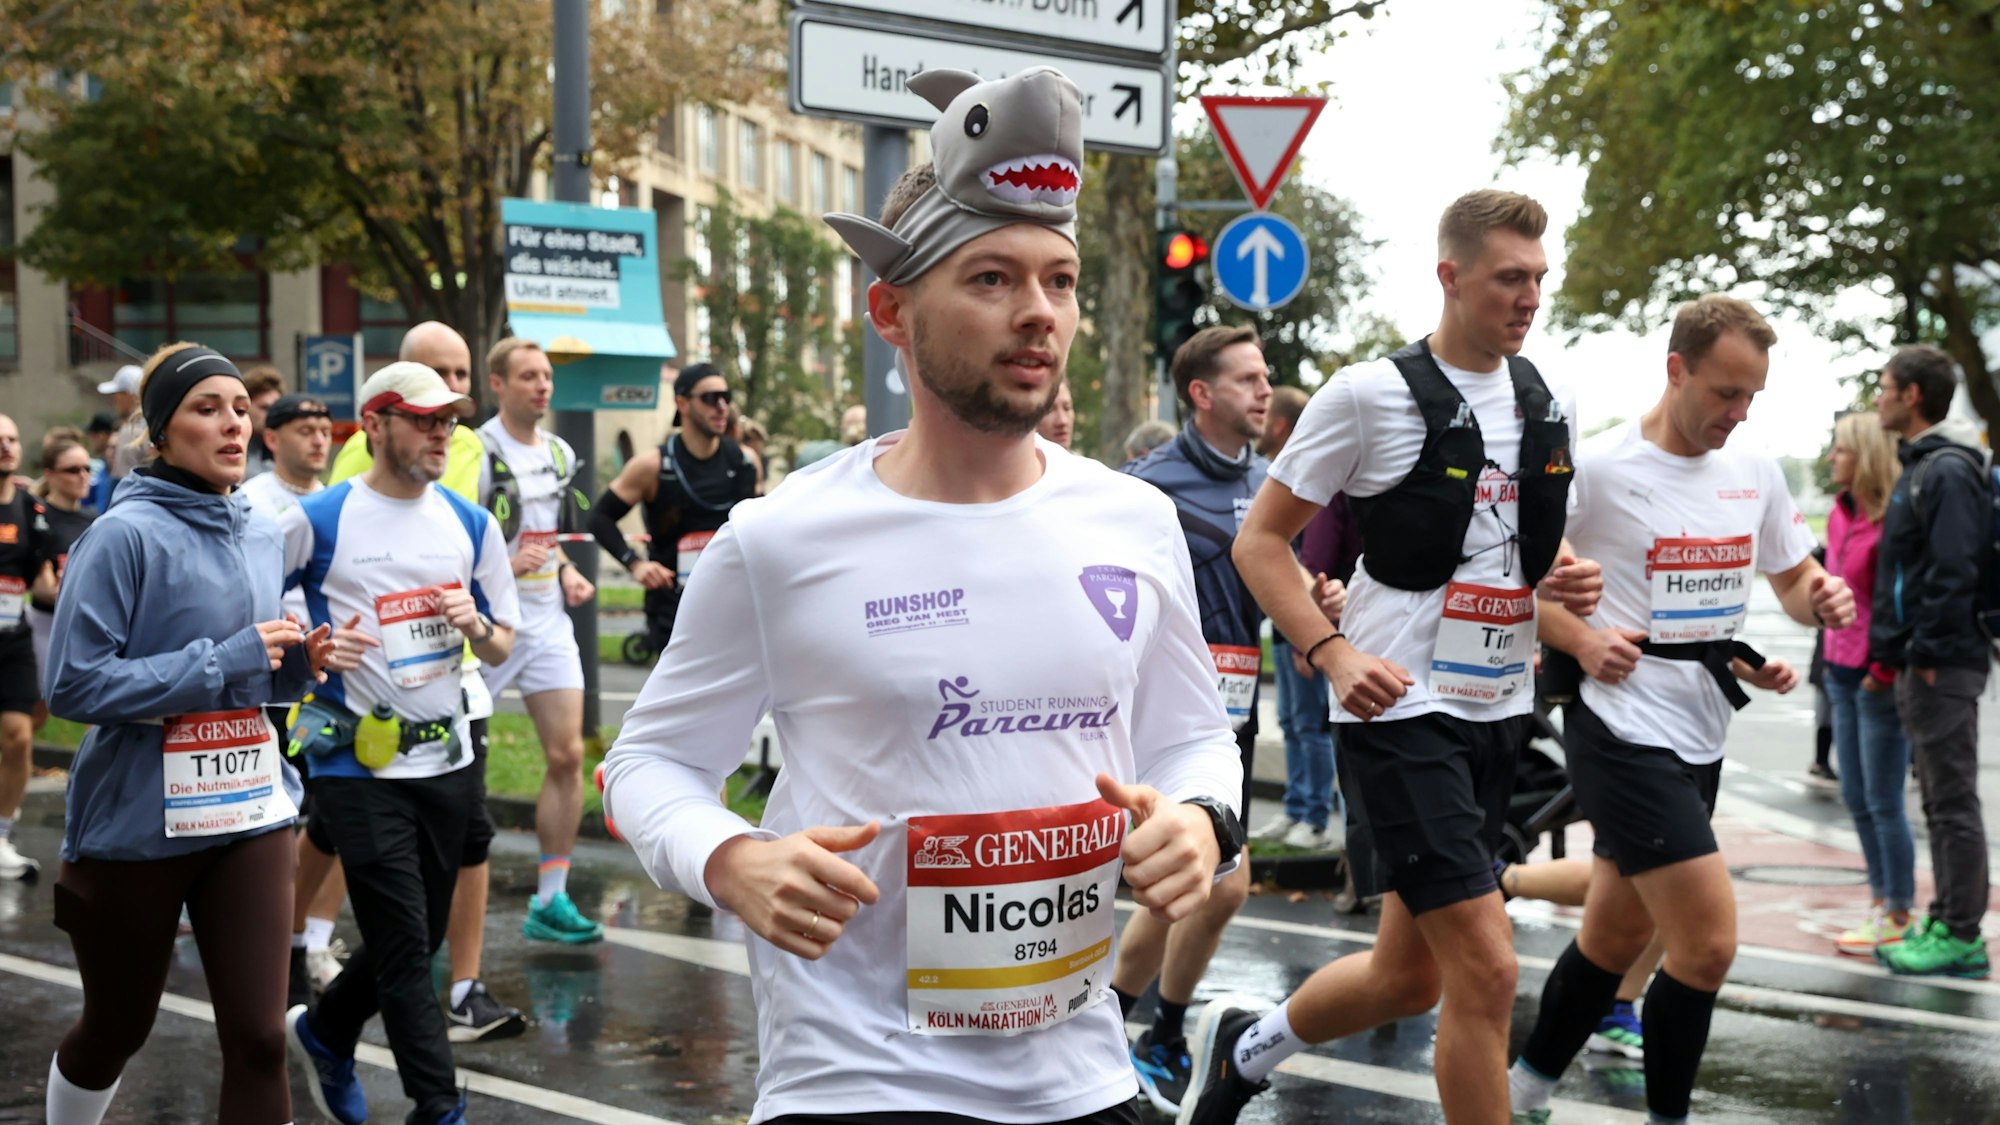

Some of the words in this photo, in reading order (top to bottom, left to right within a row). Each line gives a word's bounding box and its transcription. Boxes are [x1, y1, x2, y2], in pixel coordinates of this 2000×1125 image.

[509, 225, 542, 249] Für
[543, 228, 586, 252] eine
[587, 231, 643, 257] Stadt,
[510, 252, 542, 274] die
[543, 255, 617, 278] wächst.
[513, 283, 551, 298] Und
[1499, 484, 1519, 502] BA
[1089, 574, 1133, 586] PARCIVAL
[1667, 573, 1744, 593] Hendrik
[865, 588, 964, 619] RUNSHOP
[866, 617, 900, 628] GREG
[906, 613, 931, 622] VAN
[936, 608, 968, 618] HEST
[980, 698, 1043, 714] STUDENT
[1048, 696, 1108, 709] RUNNING
[927, 701, 1118, 741] Parcival
[190, 749, 261, 777] T1077
[169, 783, 192, 795] Die
[197, 774, 271, 793] Nutmilkmakers
[975, 811, 1121, 868] GENERALI
[944, 882, 1100, 934] Nicolas
[1014, 938, 1058, 961] 8794
[918, 975, 939, 984] 42.2
[996, 996, 1041, 1011] GENERALI
[1068, 988, 1088, 1013] PUMA
[928, 1011, 964, 1028] KÖLN
[968, 1008, 1041, 1030] MARATHON
